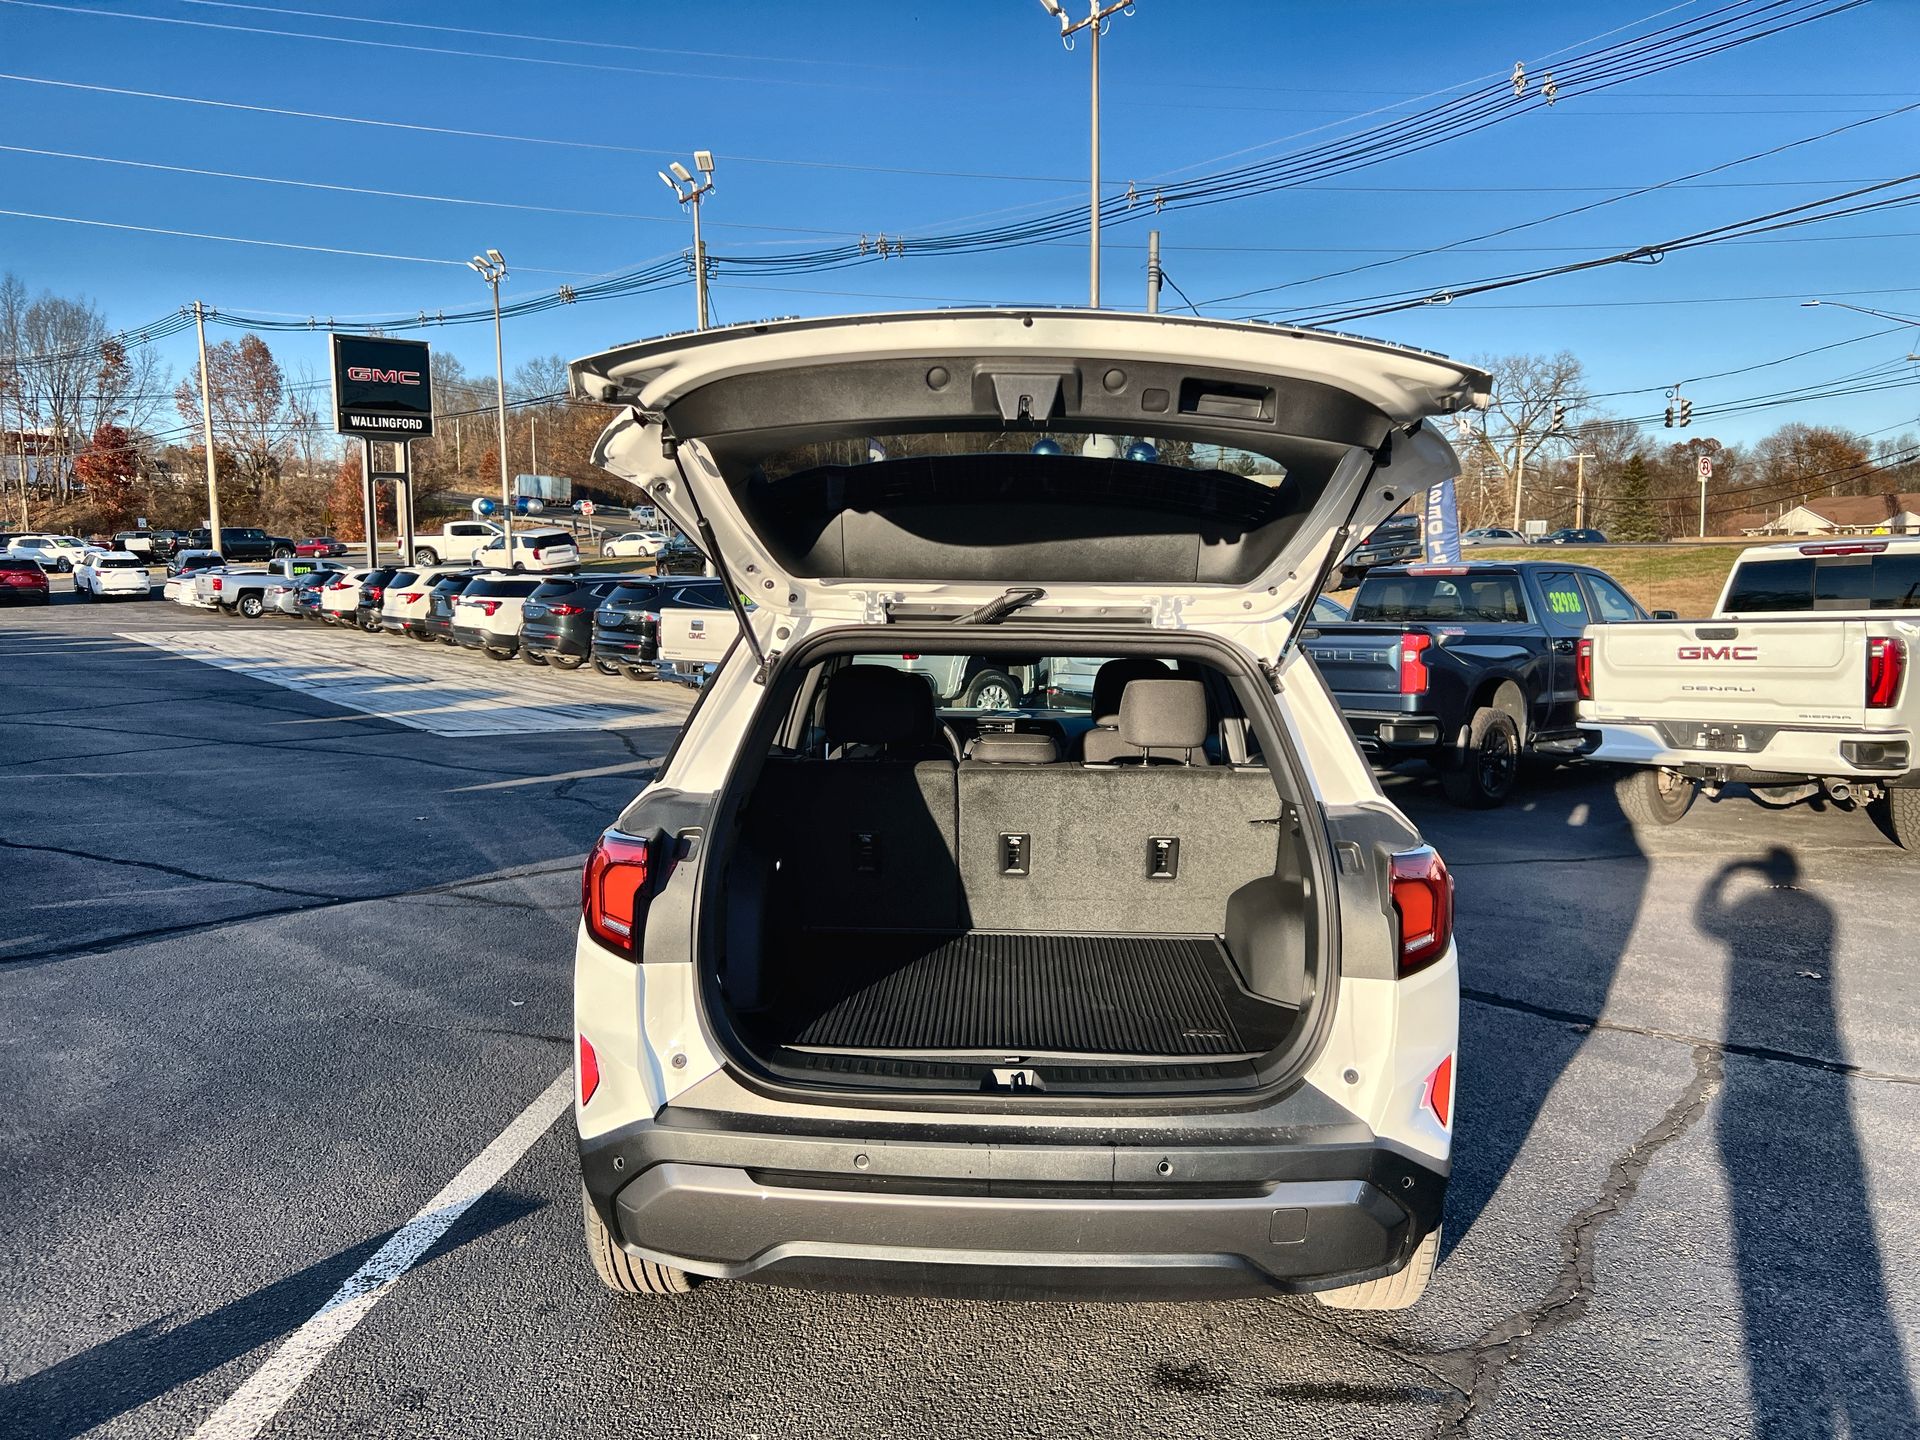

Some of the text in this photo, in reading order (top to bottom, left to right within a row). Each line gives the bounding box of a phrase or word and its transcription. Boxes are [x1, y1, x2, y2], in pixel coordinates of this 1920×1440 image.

[348, 367, 420, 385] GMC
[350, 415, 423, 430] WALLINGFORD
[1549, 591, 1581, 613] 32988
[688, 632, 706, 640] GMC
[1312, 649, 1389, 666] OLET
[1678, 646, 1758, 661] GMC
